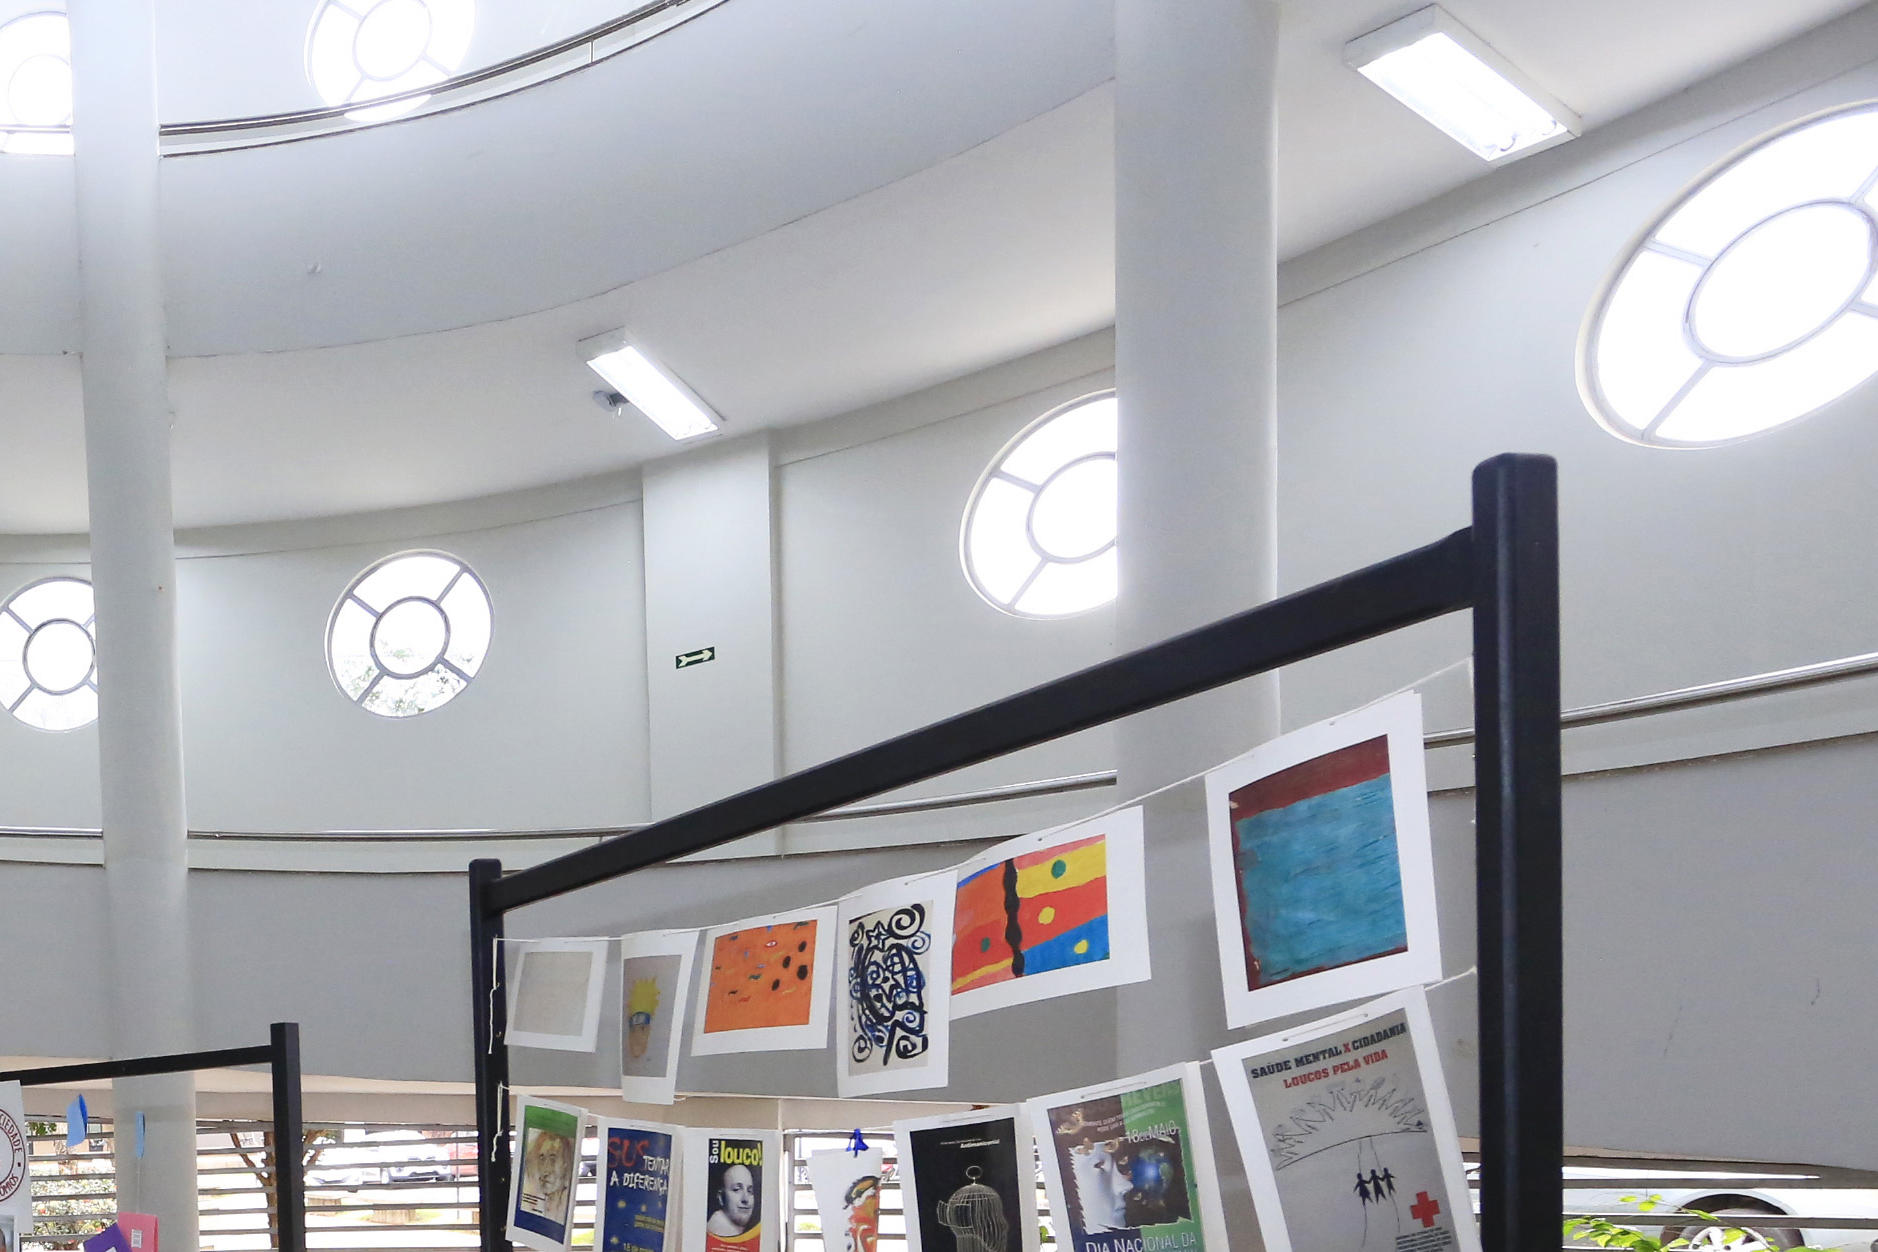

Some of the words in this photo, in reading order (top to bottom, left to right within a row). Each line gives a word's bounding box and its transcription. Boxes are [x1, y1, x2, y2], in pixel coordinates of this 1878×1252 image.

[1251, 1058, 1292, 1078] SAÚDE
[1294, 1046, 1342, 1068] MENTAL
[1343, 1043, 1352, 1054] X
[1352, 1022, 1407, 1051] CIDADANIA
[1283, 1069, 1330, 1088] LOUCOS
[1332, 1058, 1361, 1075] PELA
[1363, 1049, 1389, 1066] VIDA
[608, 1136, 651, 1169] SUS
[709, 1140, 720, 1164] Sou
[720, 1140, 763, 1166] louco!
[610, 1170, 619, 1188] A
[1181, 1232, 1197, 1247] DA
